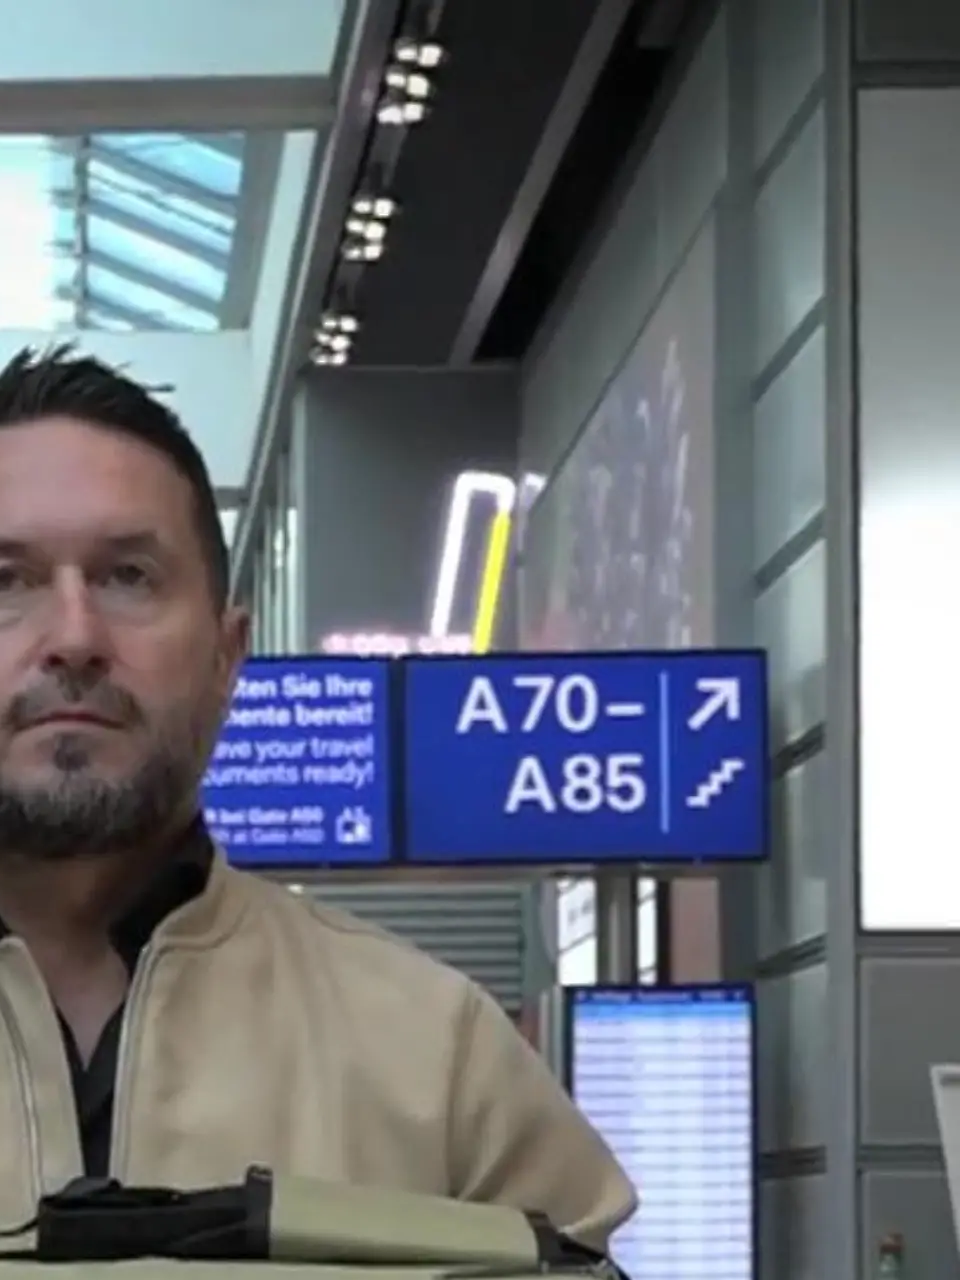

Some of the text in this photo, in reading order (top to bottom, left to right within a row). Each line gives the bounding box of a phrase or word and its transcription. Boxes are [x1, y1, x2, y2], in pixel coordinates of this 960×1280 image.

[282, 673, 321, 699] Sie
[325, 674, 373, 697] Ihre
[295, 702, 374, 726] bereit!
[255, 741, 306, 762] your
[311, 735, 374, 758] travel
[303, 761, 374, 789] ready!
[504, 755, 646, 814] A85
